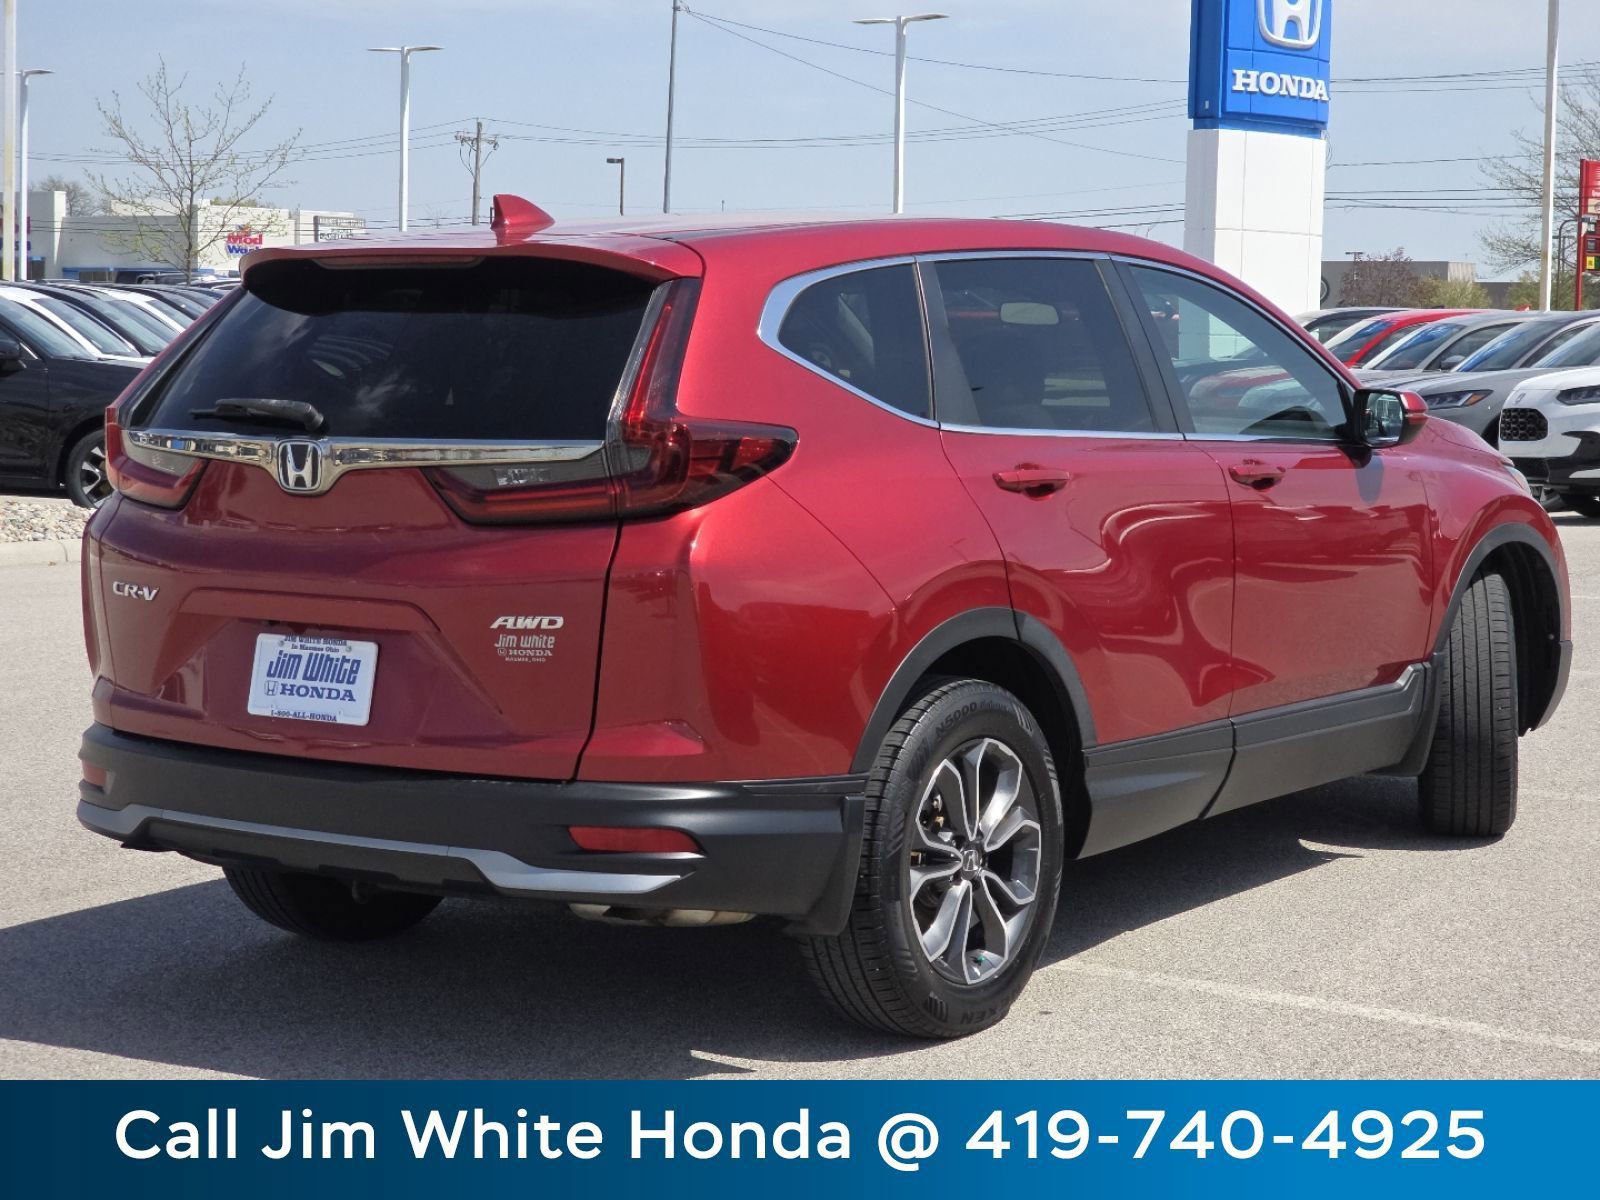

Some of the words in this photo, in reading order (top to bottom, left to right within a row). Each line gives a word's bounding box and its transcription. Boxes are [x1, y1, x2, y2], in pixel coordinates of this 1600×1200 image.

[1232, 69, 1330, 101] HONDA
[112, 580, 160, 601] CR-V
[489, 615, 564, 629] AWD
[494, 634, 517, 648] Jim
[509, 649, 552, 657] HONDA
[266, 650, 303, 680] Jim
[302, 652, 361, 685] White
[280, 682, 356, 702] HONDA
[271, 709, 337, 722] 1-800-ALL-HONDA
